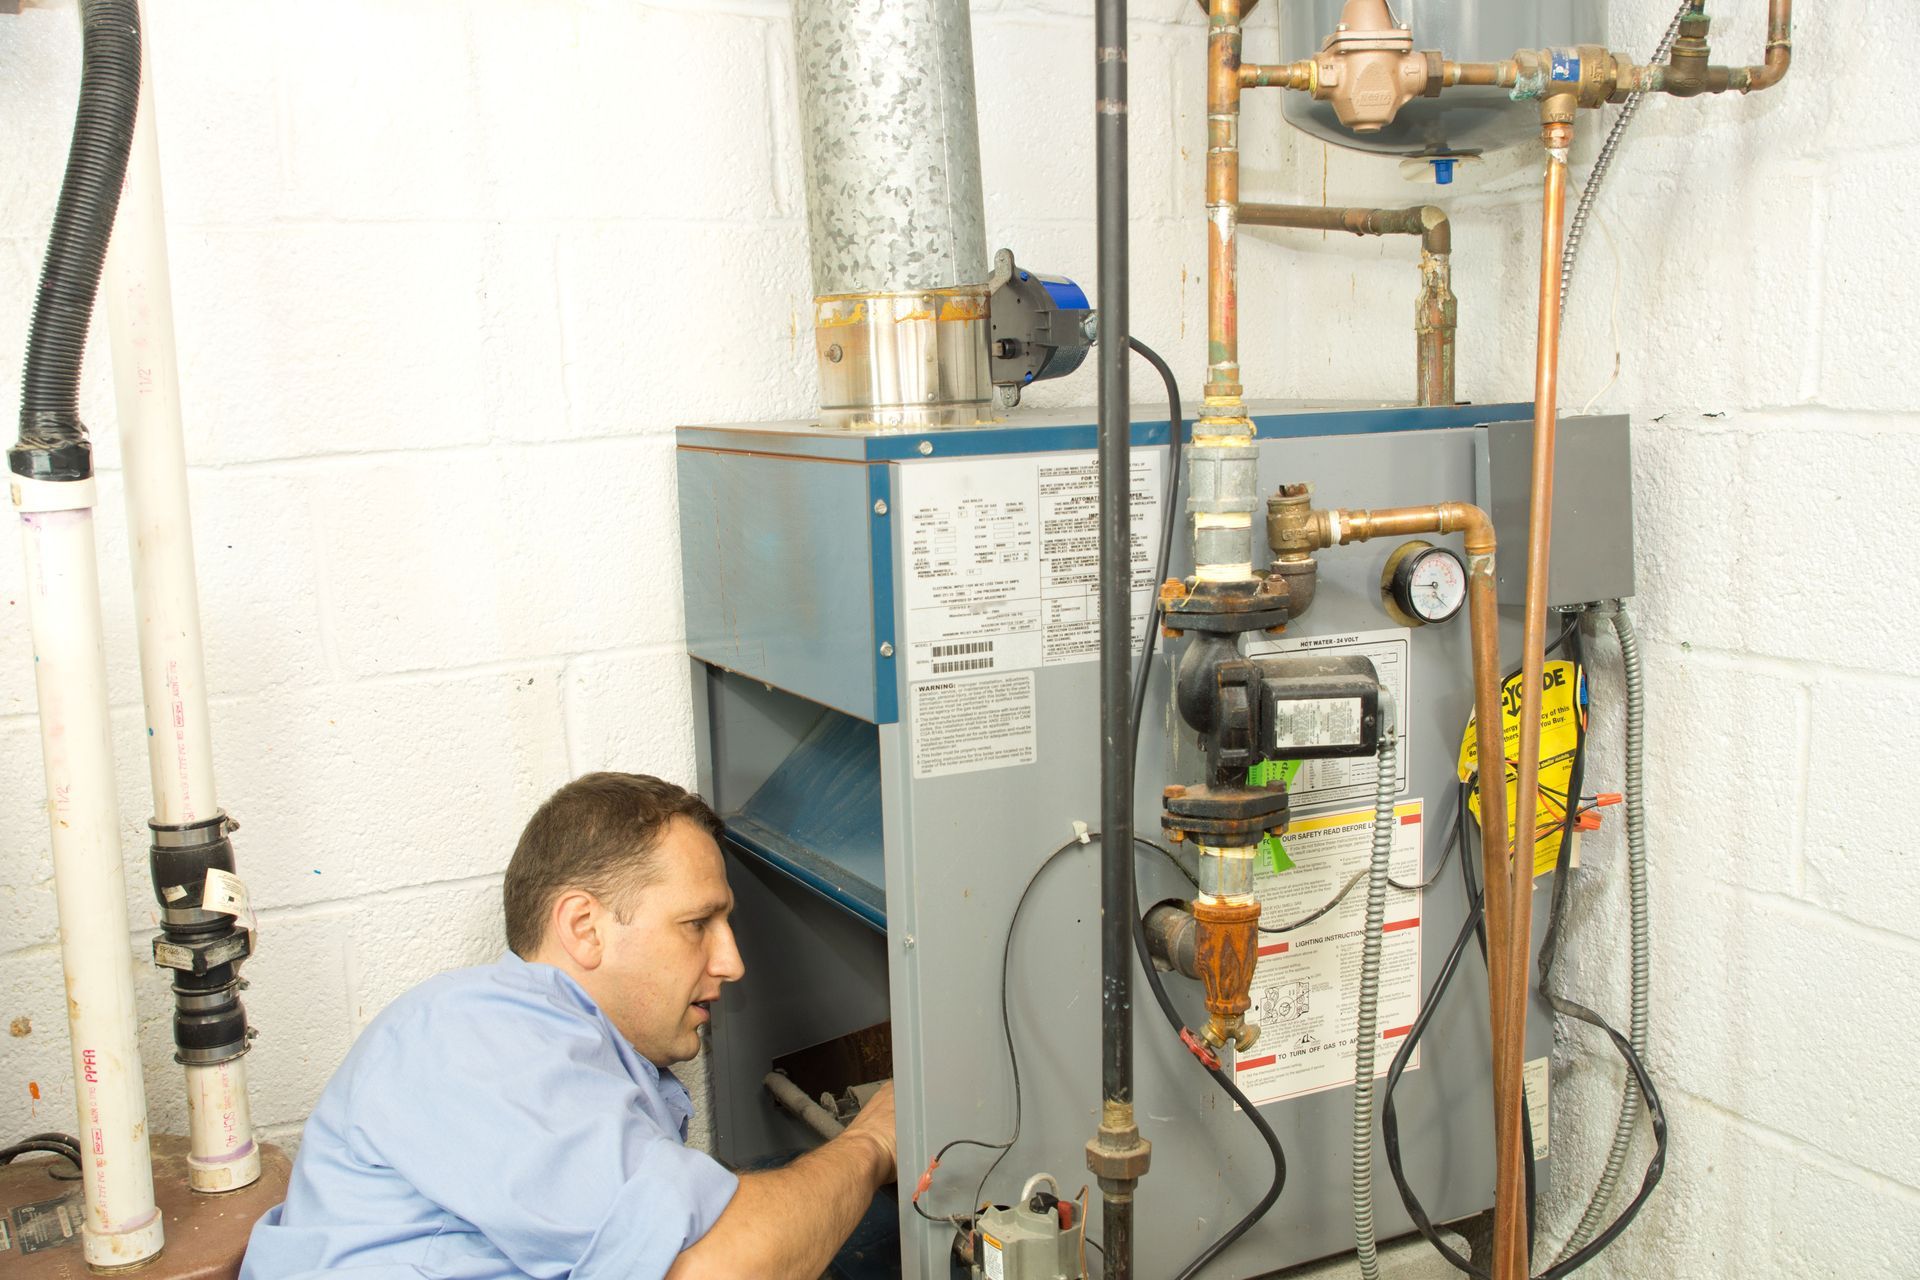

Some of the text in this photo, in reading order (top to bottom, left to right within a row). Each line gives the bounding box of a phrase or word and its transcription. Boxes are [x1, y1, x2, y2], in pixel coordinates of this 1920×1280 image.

[1313, 638, 1333, 646] WATER
[918, 683, 956, 692] WARNING:
[1550, 709, 1557, 718] of
[1557, 706, 1570, 714] this
[1282, 834, 1297, 842] OUR
[1298, 831, 1322, 840] SAFETY
[1342, 824, 1367, 833] BEFORE
[1295, 931, 1366, 948] LIGHTING INSTRUCTION
[1290, 1049, 1306, 1058] TURN
[83, 1049, 98, 1083] PPFA
